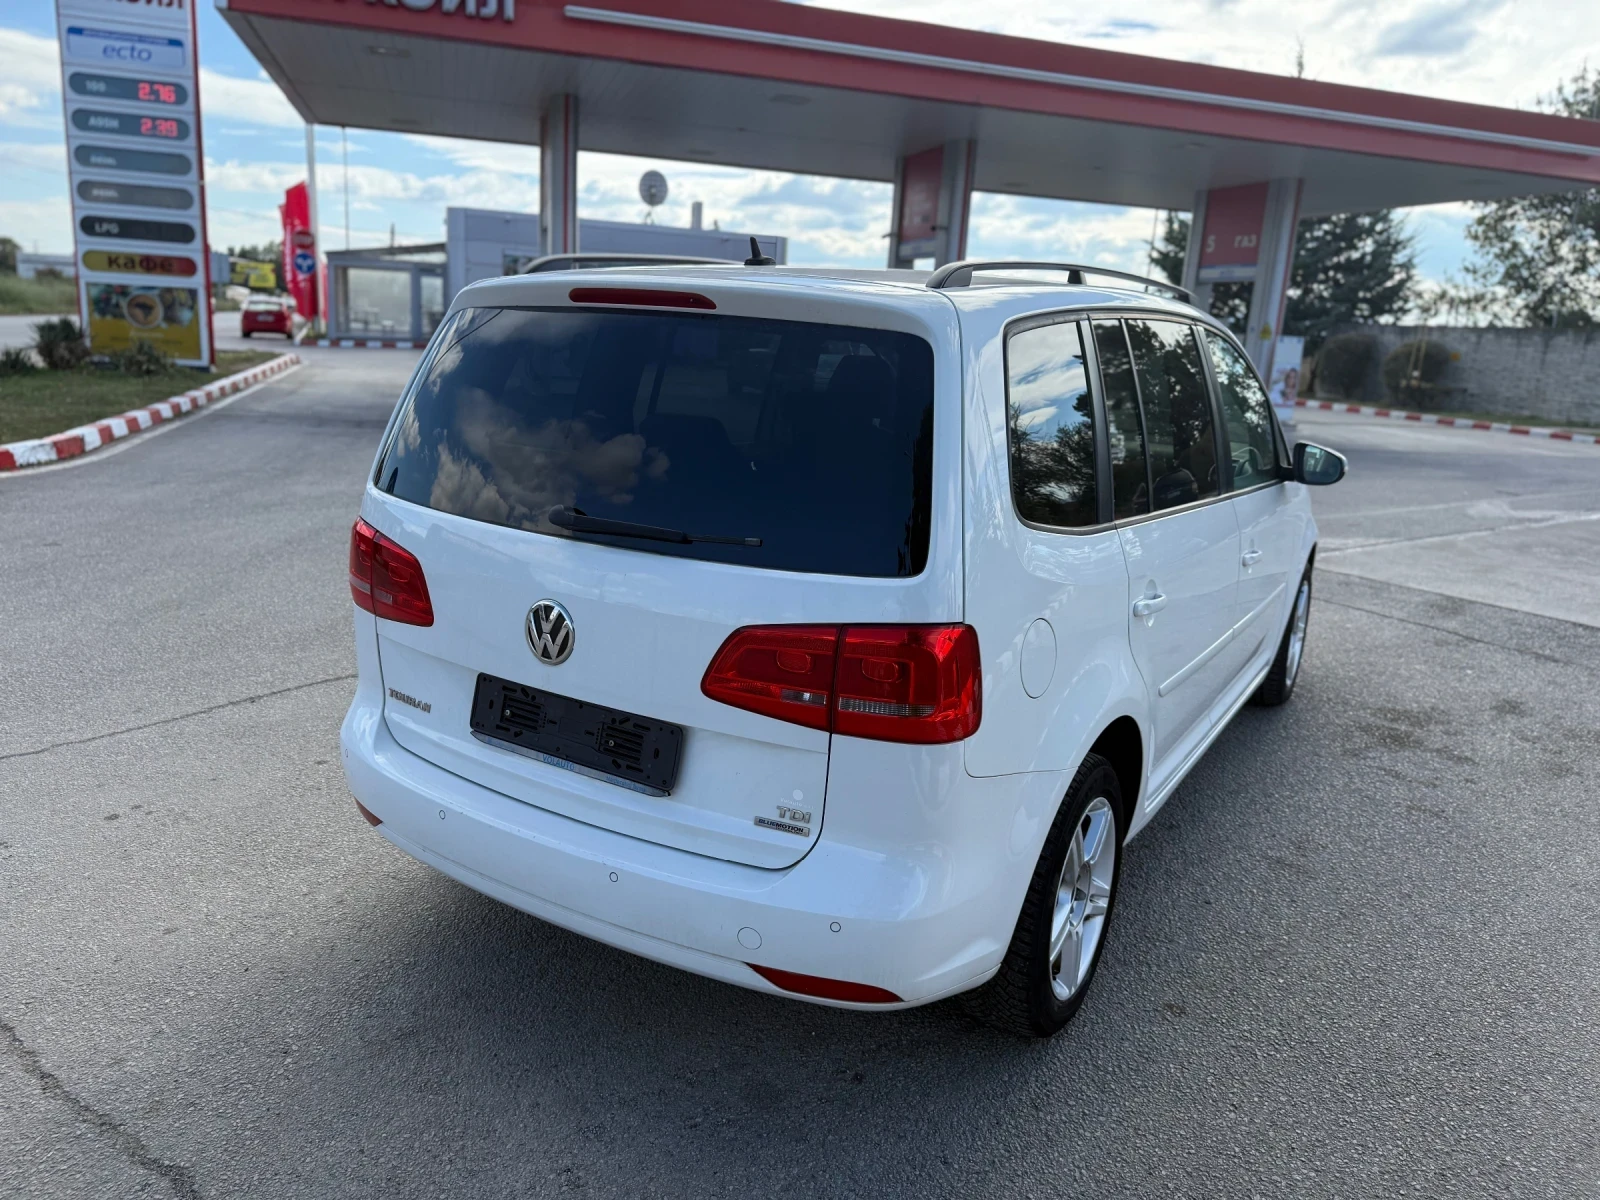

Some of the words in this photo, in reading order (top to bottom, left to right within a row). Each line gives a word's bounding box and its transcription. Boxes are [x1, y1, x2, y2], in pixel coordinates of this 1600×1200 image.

[102, 44, 152, 62] ecto
[137, 81, 177, 104] 2.76
[140, 117, 179, 138] 2.39
[94, 221, 120, 235] LPG
[1234, 234, 1257, 248] ГАЗ
[543, 753, 575, 771] VOLAUTO
[776, 805, 811, 823] TDI
[758, 818, 803, 832] BLUEMOTION
